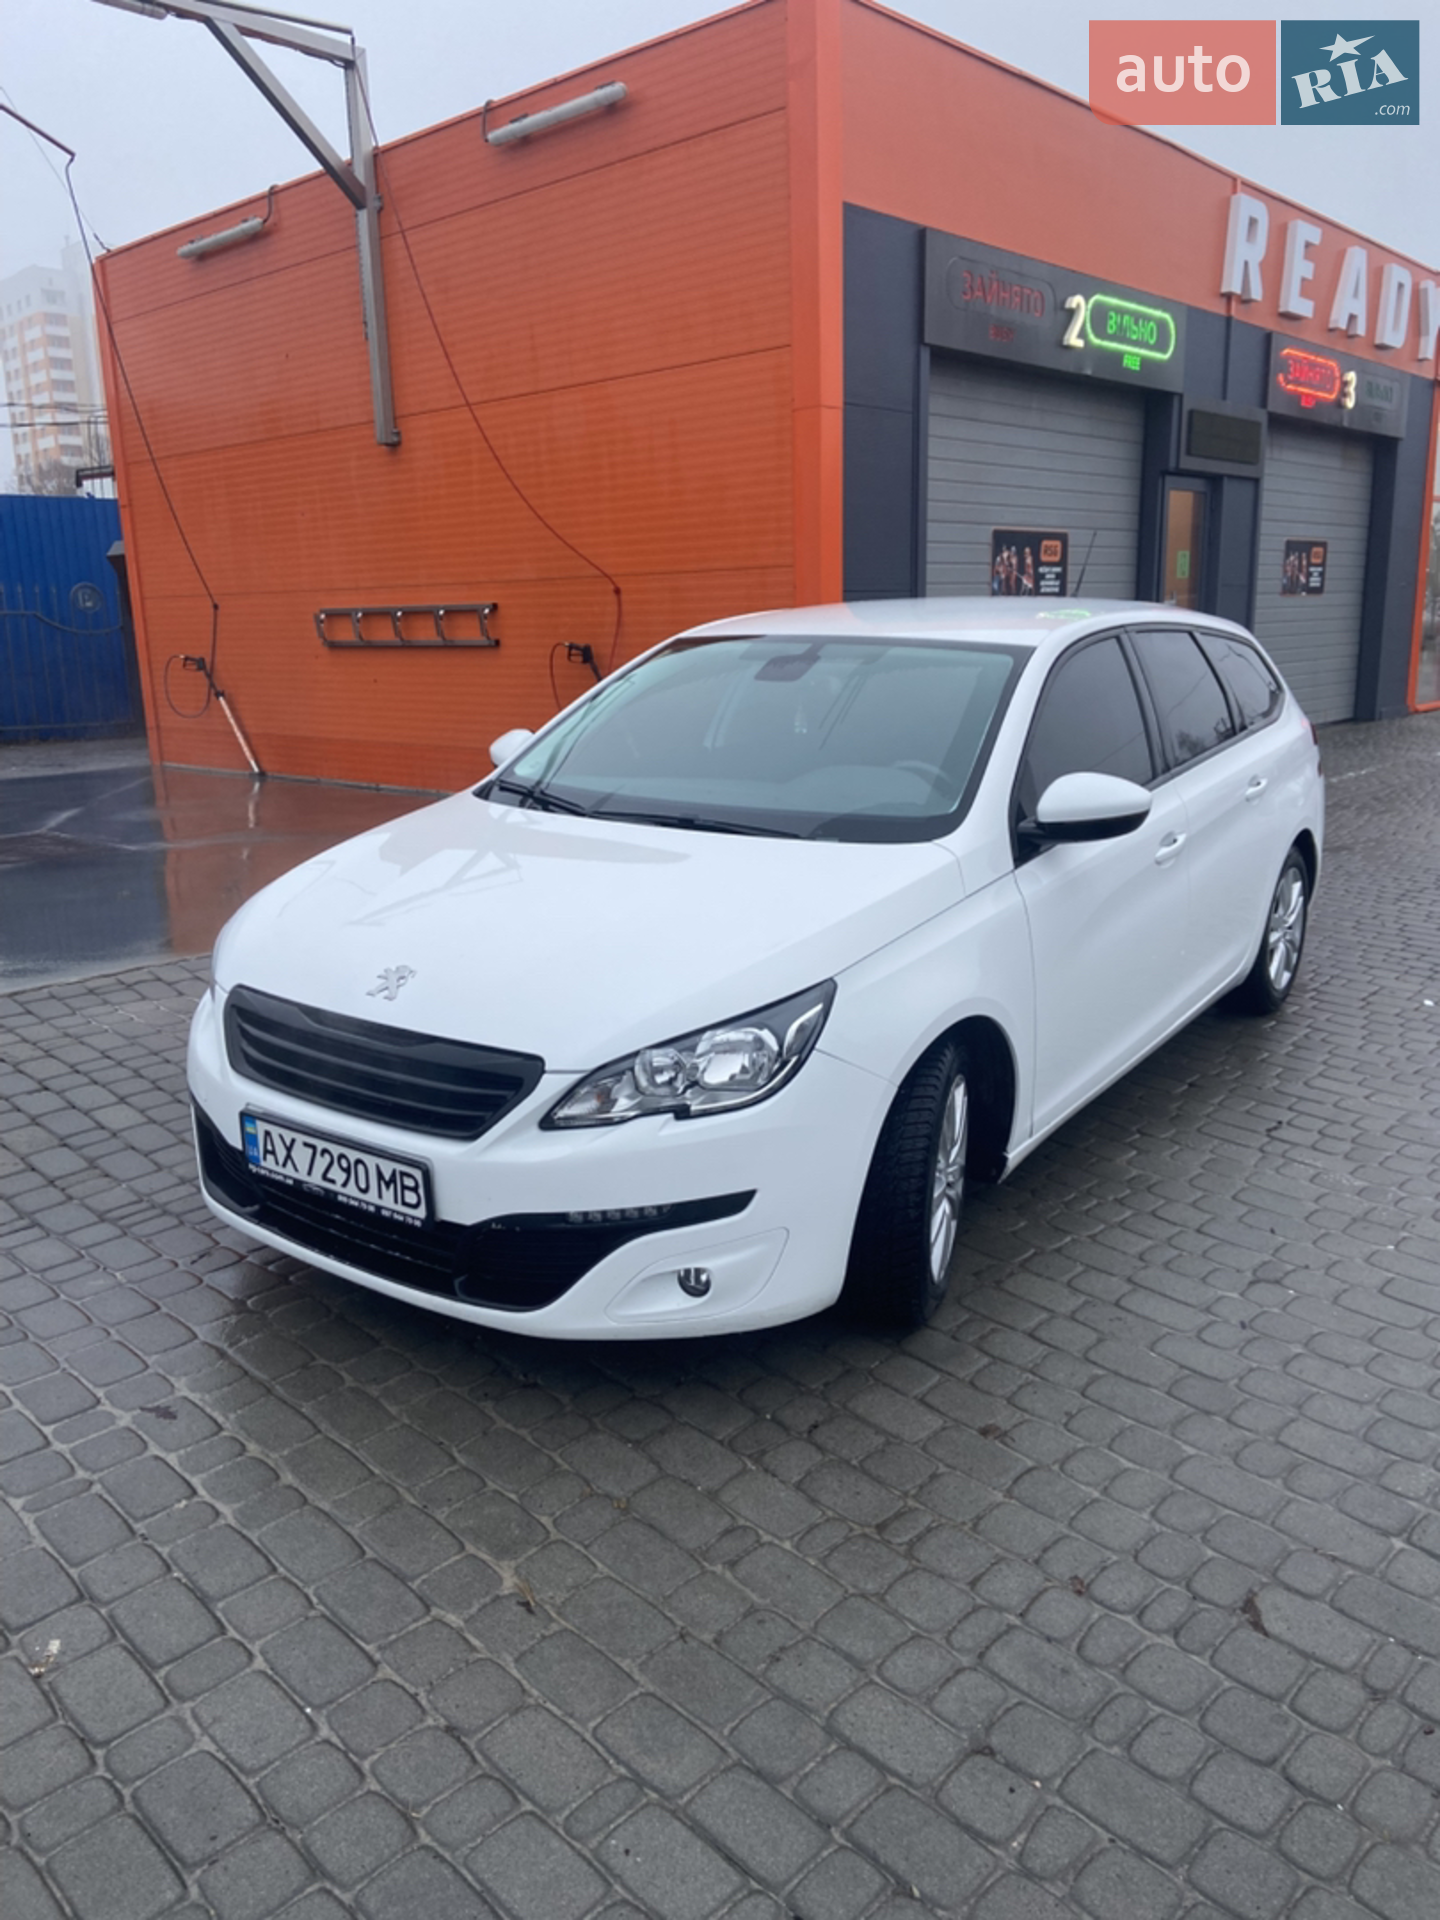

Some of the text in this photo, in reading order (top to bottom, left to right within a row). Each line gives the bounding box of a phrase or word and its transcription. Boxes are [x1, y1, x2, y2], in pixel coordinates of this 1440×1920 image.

[961, 269, 1046, 318] ЗАЙНЯТО
[1063, 294, 1087, 348] 2
[1342, 370, 1358, 409] 3
